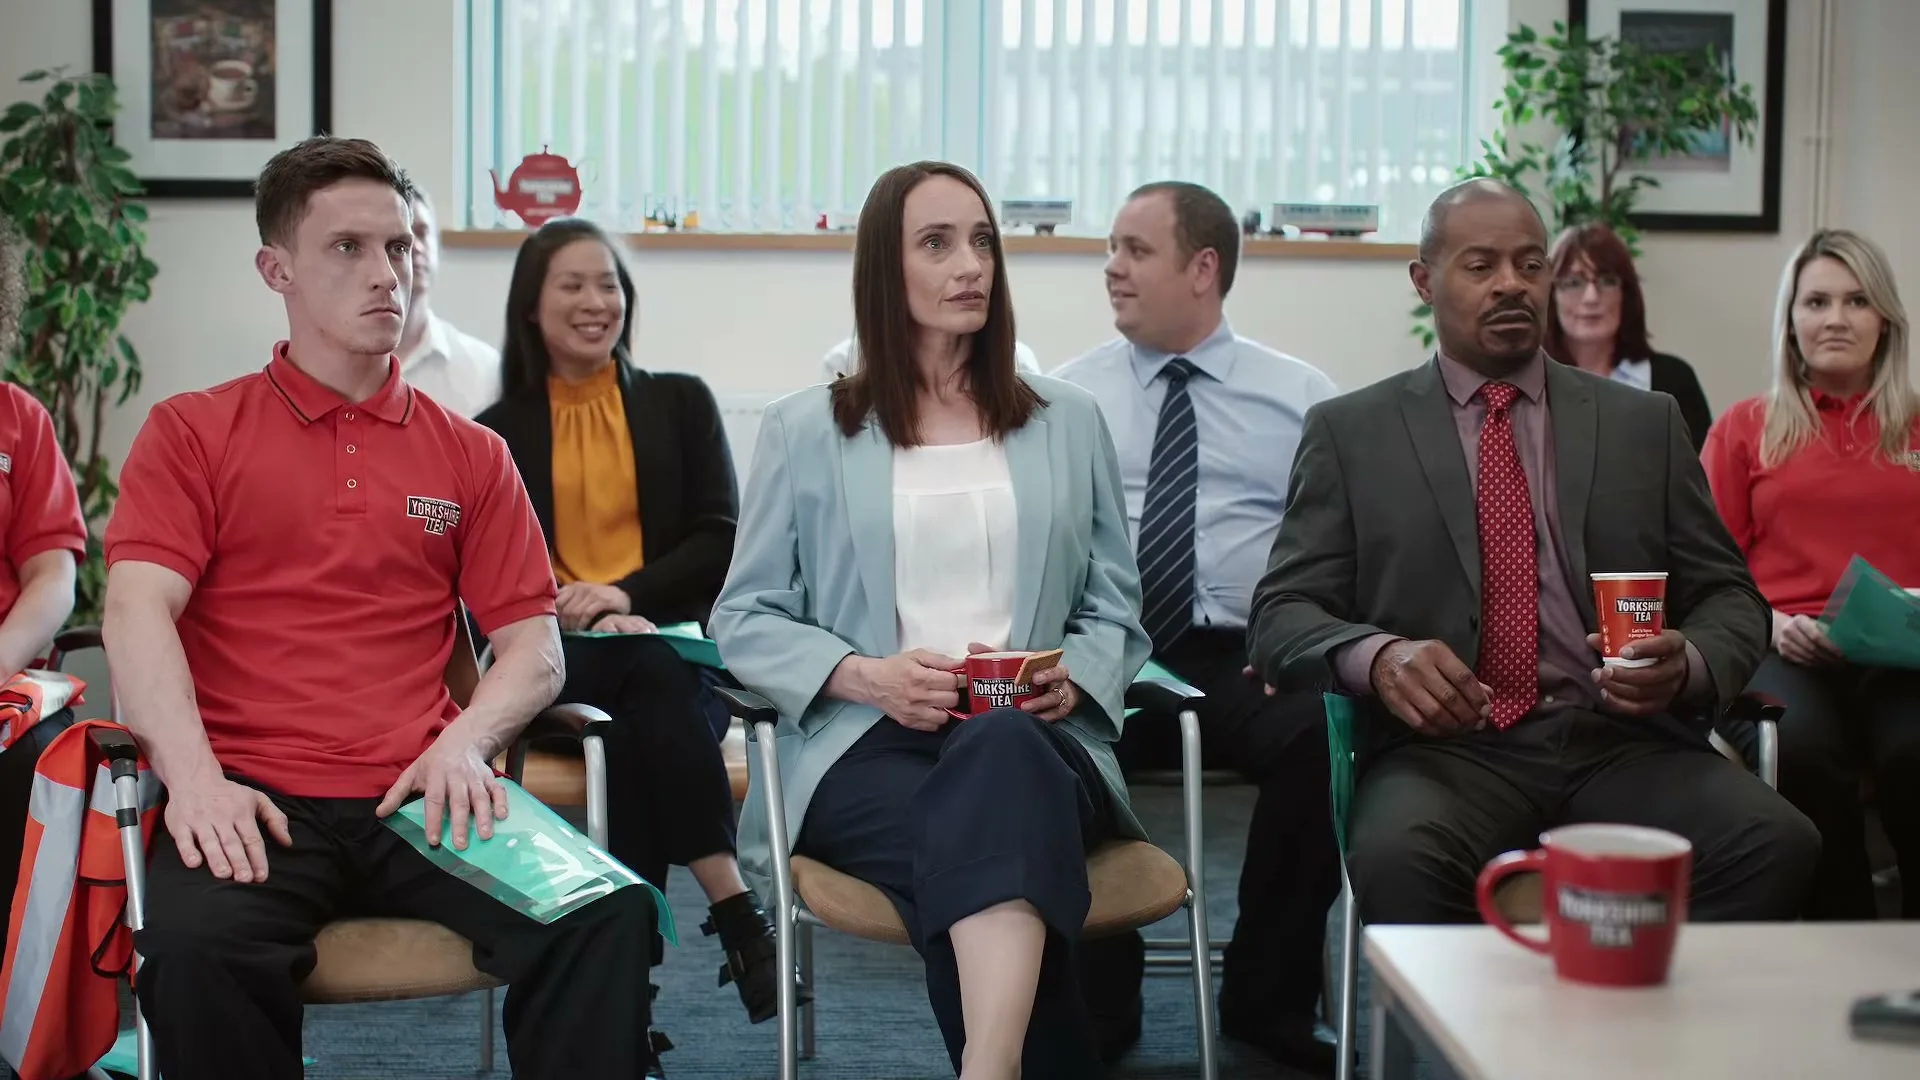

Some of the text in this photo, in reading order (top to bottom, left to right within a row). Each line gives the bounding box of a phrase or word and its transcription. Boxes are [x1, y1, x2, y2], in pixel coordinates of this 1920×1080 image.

[411, 499, 460, 524] YORKSHIRE
[429, 517, 445, 532] TEA
[1616, 599, 1664, 612] YORKSHIRE
[1634, 611, 1652, 622] TEA
[973, 680, 1031, 695] YORKSHIRE
[990, 695, 1012, 707] TEA
